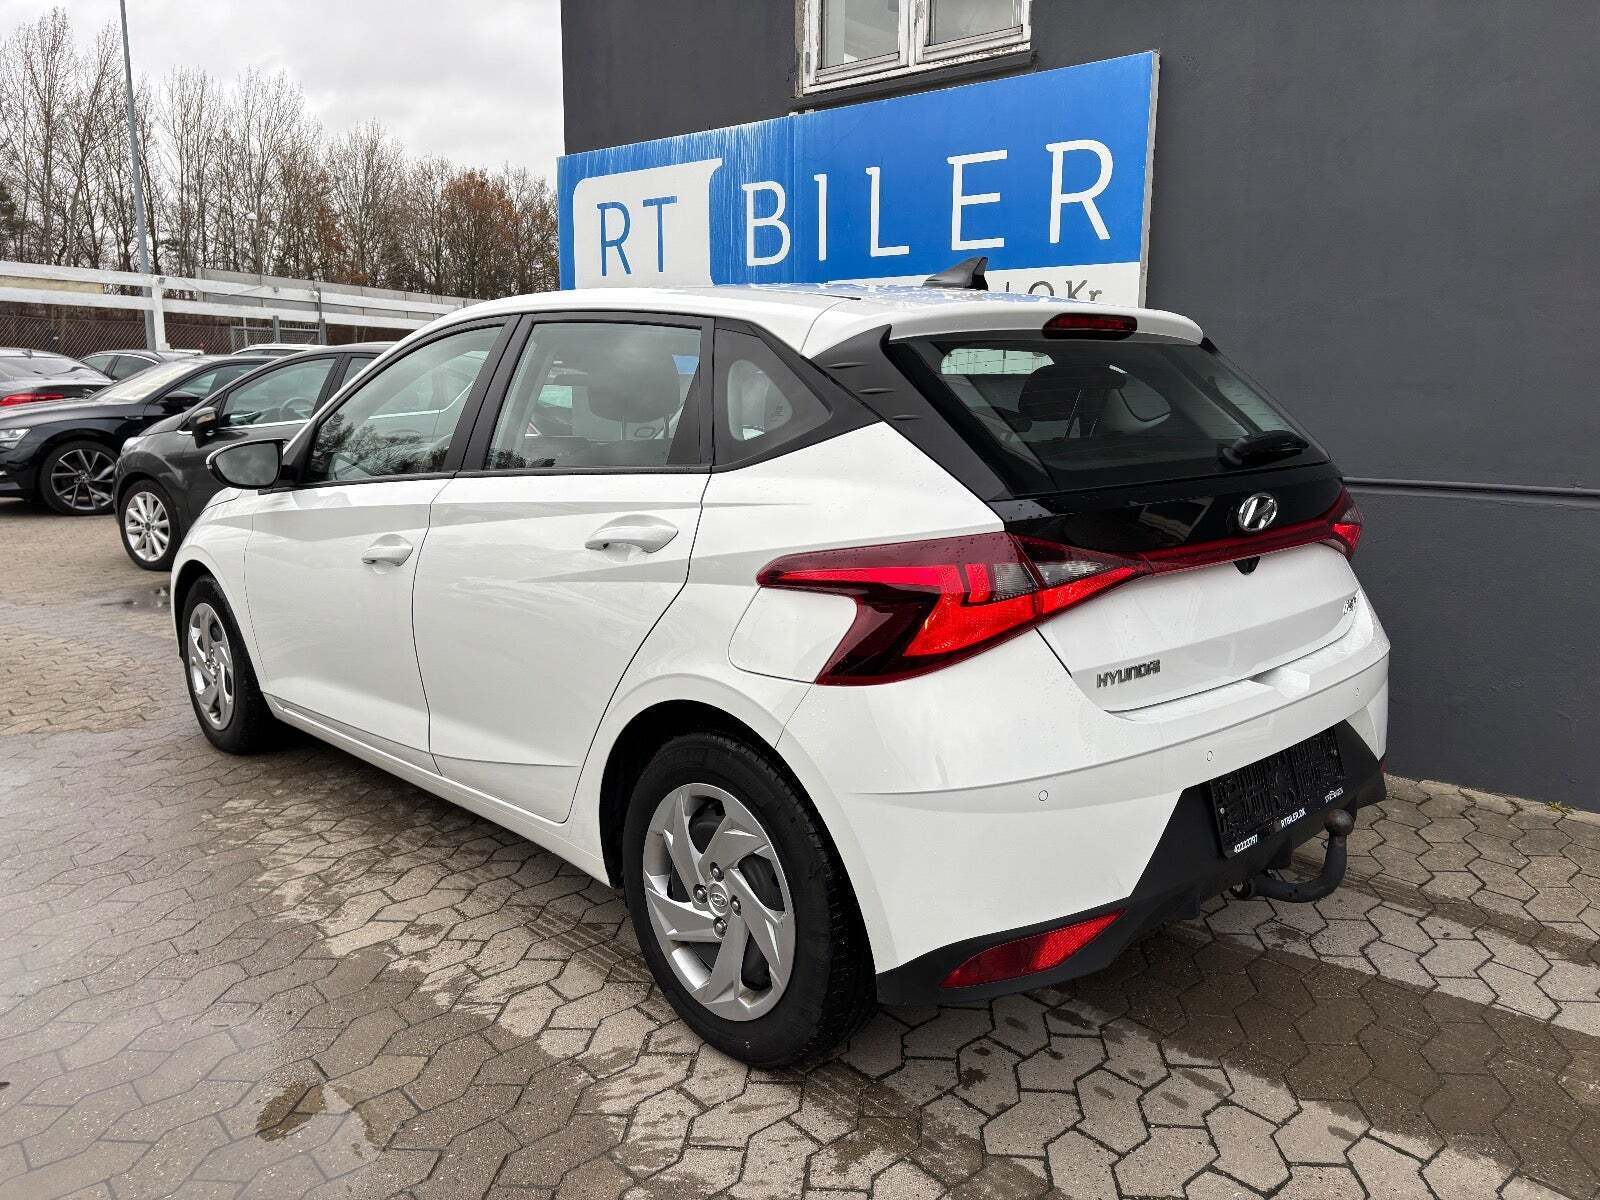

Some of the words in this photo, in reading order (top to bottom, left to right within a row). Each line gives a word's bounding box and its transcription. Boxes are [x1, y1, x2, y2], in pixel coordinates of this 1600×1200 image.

[596, 194, 679, 278] RT
[742, 138, 1114, 268] BILER
[1096, 659, 1161, 688] HYUNDAI
